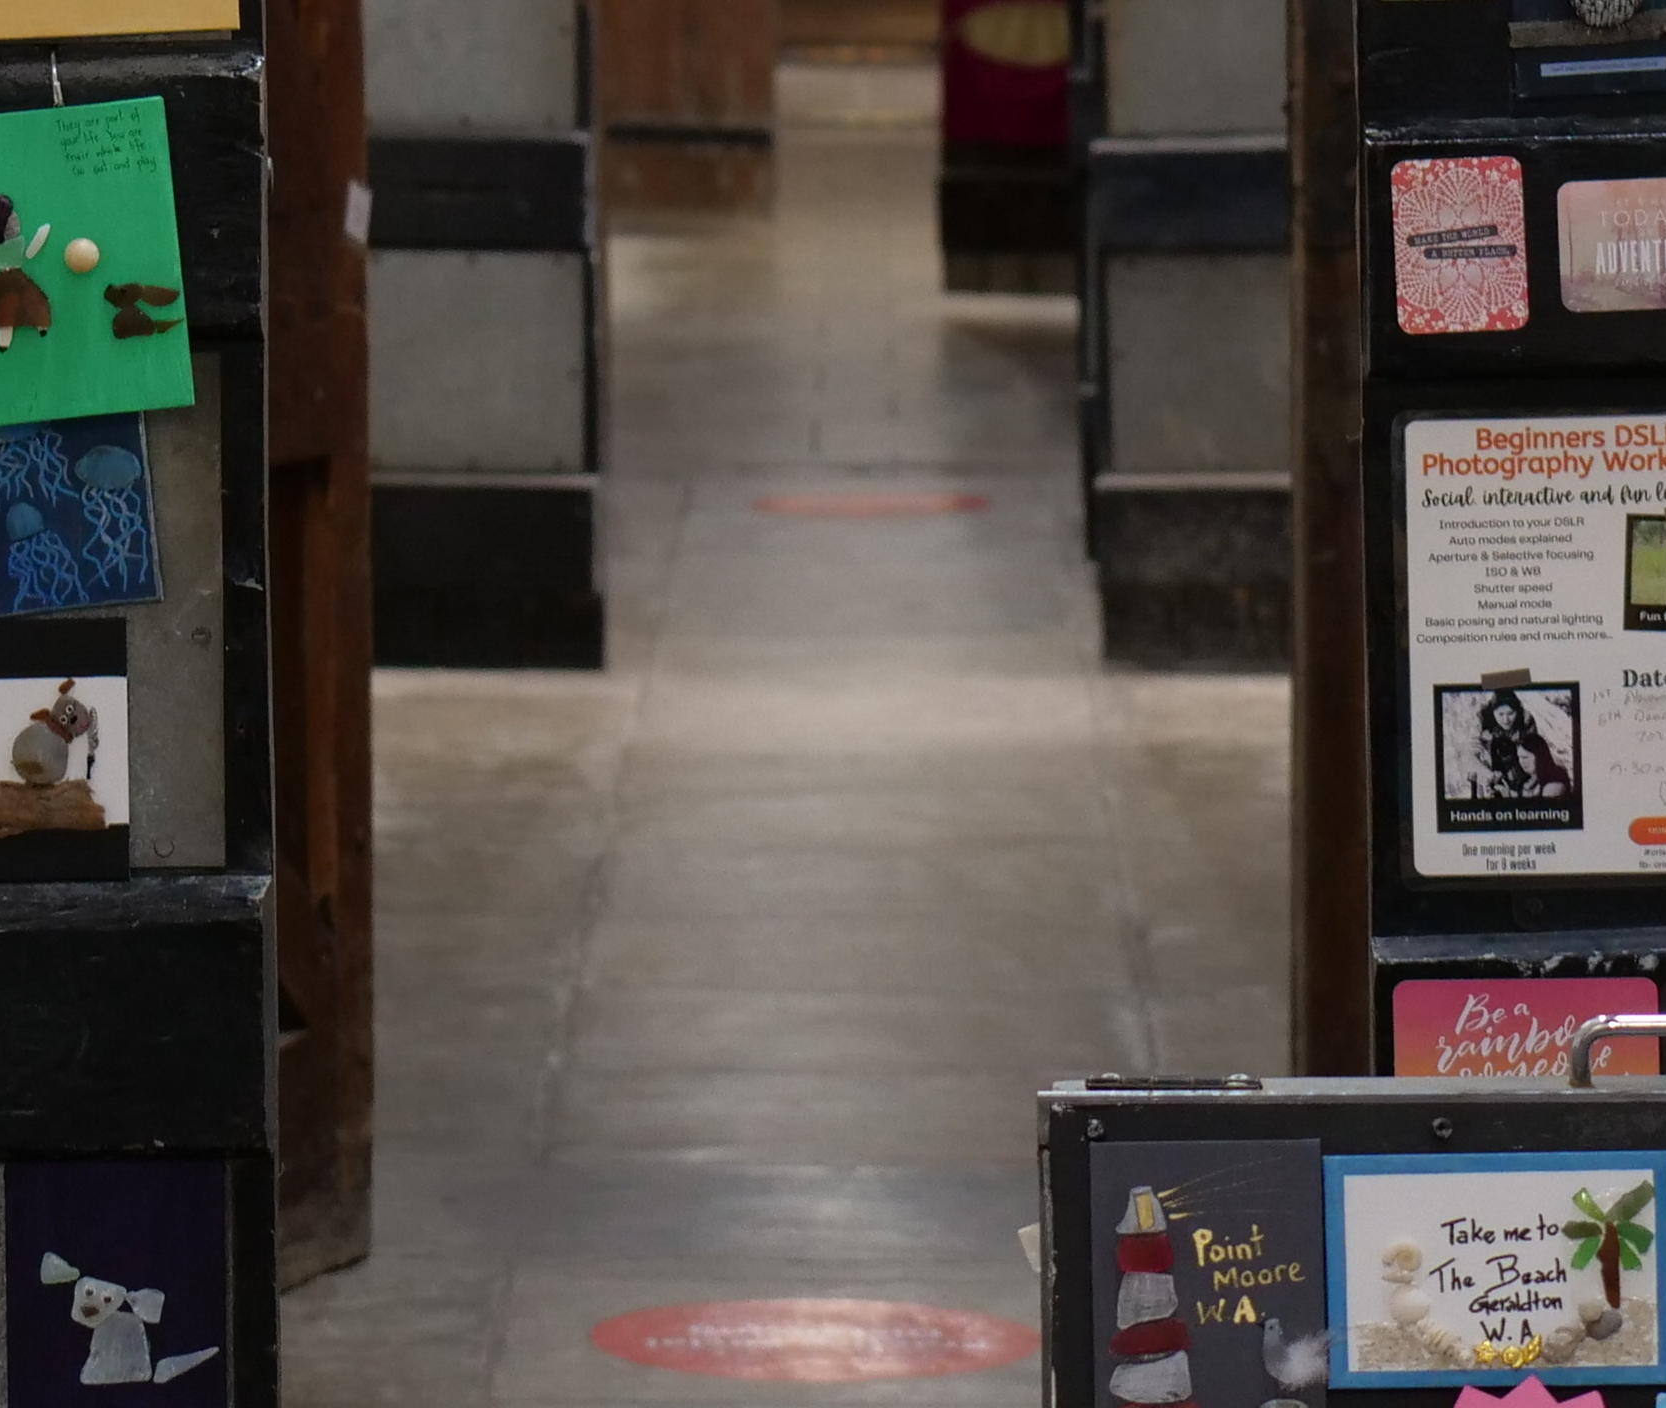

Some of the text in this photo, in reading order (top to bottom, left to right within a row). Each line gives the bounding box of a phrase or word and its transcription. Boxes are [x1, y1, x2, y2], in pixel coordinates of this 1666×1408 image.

[1476, 426, 1606, 456] Beginners
[1422, 451, 1594, 480] Photography
[1483, 485, 1573, 506] interactive
[1580, 485, 1615, 506] and
[1621, 482, 1652, 504] fun
[1439, 516, 1584, 532] Introduction to your DSLR
[1448, 532, 1572, 547] Auto modes explained
[1428, 551, 1477, 564] Aperture
[1491, 549, 1544, 562] Selective
[1546, 547, 1594, 562] focusing
[1485, 566, 1508, 577] ISO
[1473, 582, 1553, 595] Shutter speed
[1477, 598, 1553, 610] Manual mode
[1424, 612, 1604, 629] Basic posing and natural lighting
[1639, 611, 1660, 623] Fun
[1416, 631, 1488, 645] Composition
[1490, 630, 1517, 643] rules
[1519, 630, 1541, 641] and
[1543, 629, 1575, 641] much
[1450, 807, 1570, 823] Hands on learning
[1462, 842, 1557, 859] One morning per week
[1486, 858, 1499, 871] for
[1510, 857, 1536, 870] weeks
[1455, 993, 1530, 1035] Be a
[1437, 1015, 1579, 1073] rainbo
[1442, 1213, 1560, 1248] Take me to
[1193, 1224, 1265, 1266] Point
[1212, 1259, 1306, 1291] Moore
[1429, 1255, 1568, 1295] The Beach
[1468, 1290, 1564, 1316] Geraldton
